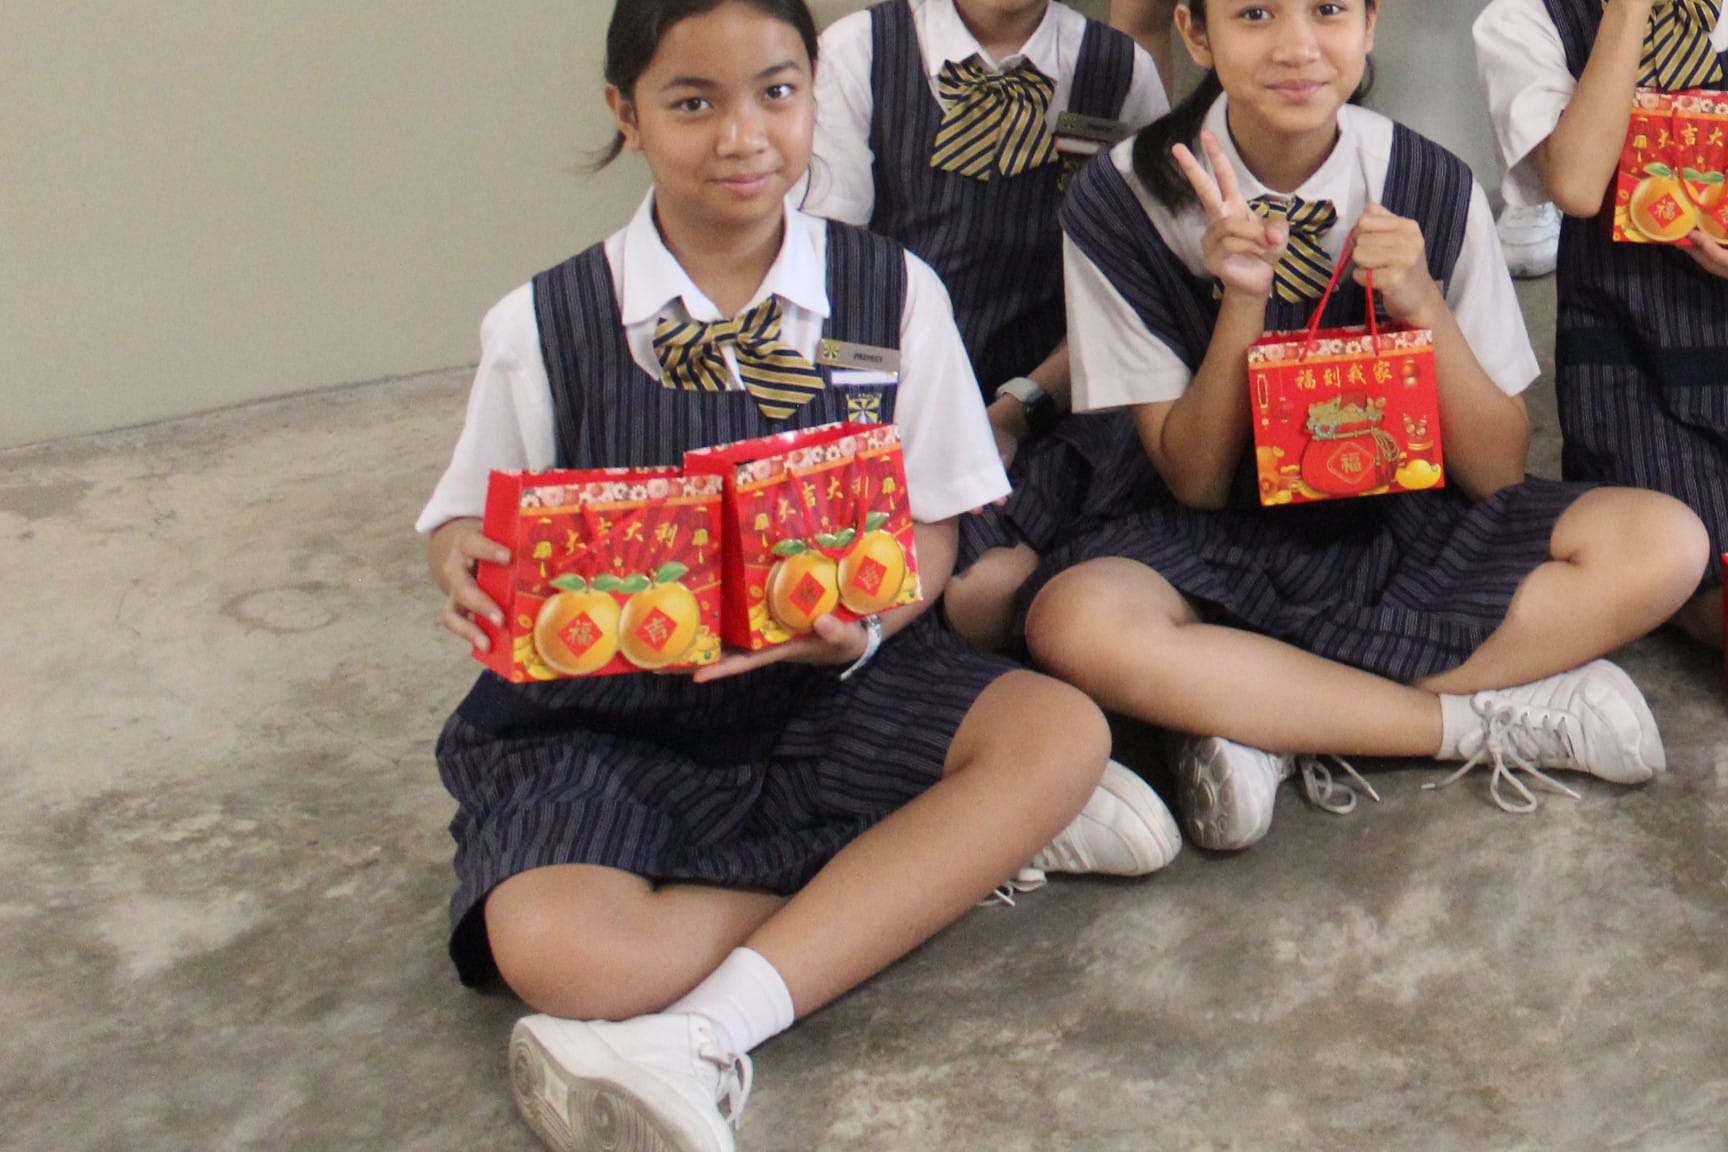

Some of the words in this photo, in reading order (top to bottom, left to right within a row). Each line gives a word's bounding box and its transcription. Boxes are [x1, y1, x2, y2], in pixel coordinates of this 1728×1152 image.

[1655, 199, 1676, 221] 福
[1295, 359, 1393, 391] 福到我家
[1341, 452, 1363, 473] 福
[567, 619, 594, 646] 福
